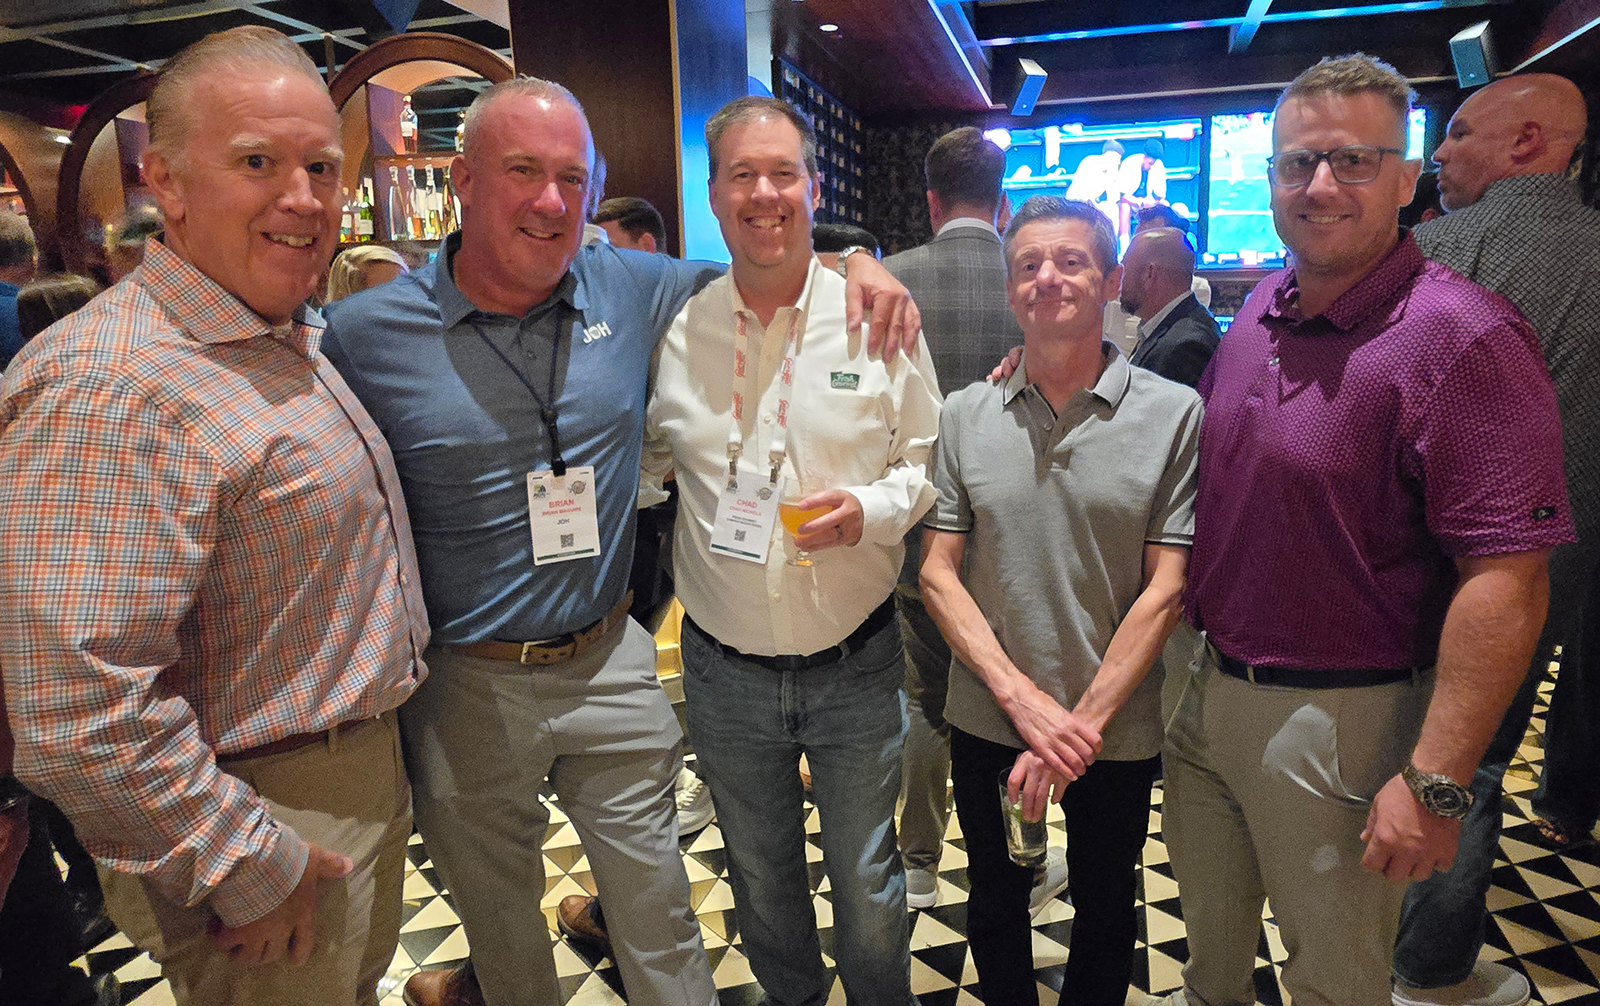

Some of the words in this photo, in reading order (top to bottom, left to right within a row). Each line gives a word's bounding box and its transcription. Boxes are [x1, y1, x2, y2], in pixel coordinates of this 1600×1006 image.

[583, 321, 612, 343] JOH
[549, 499, 574, 508] BRIAN
[737, 499, 758, 508] CHAD
